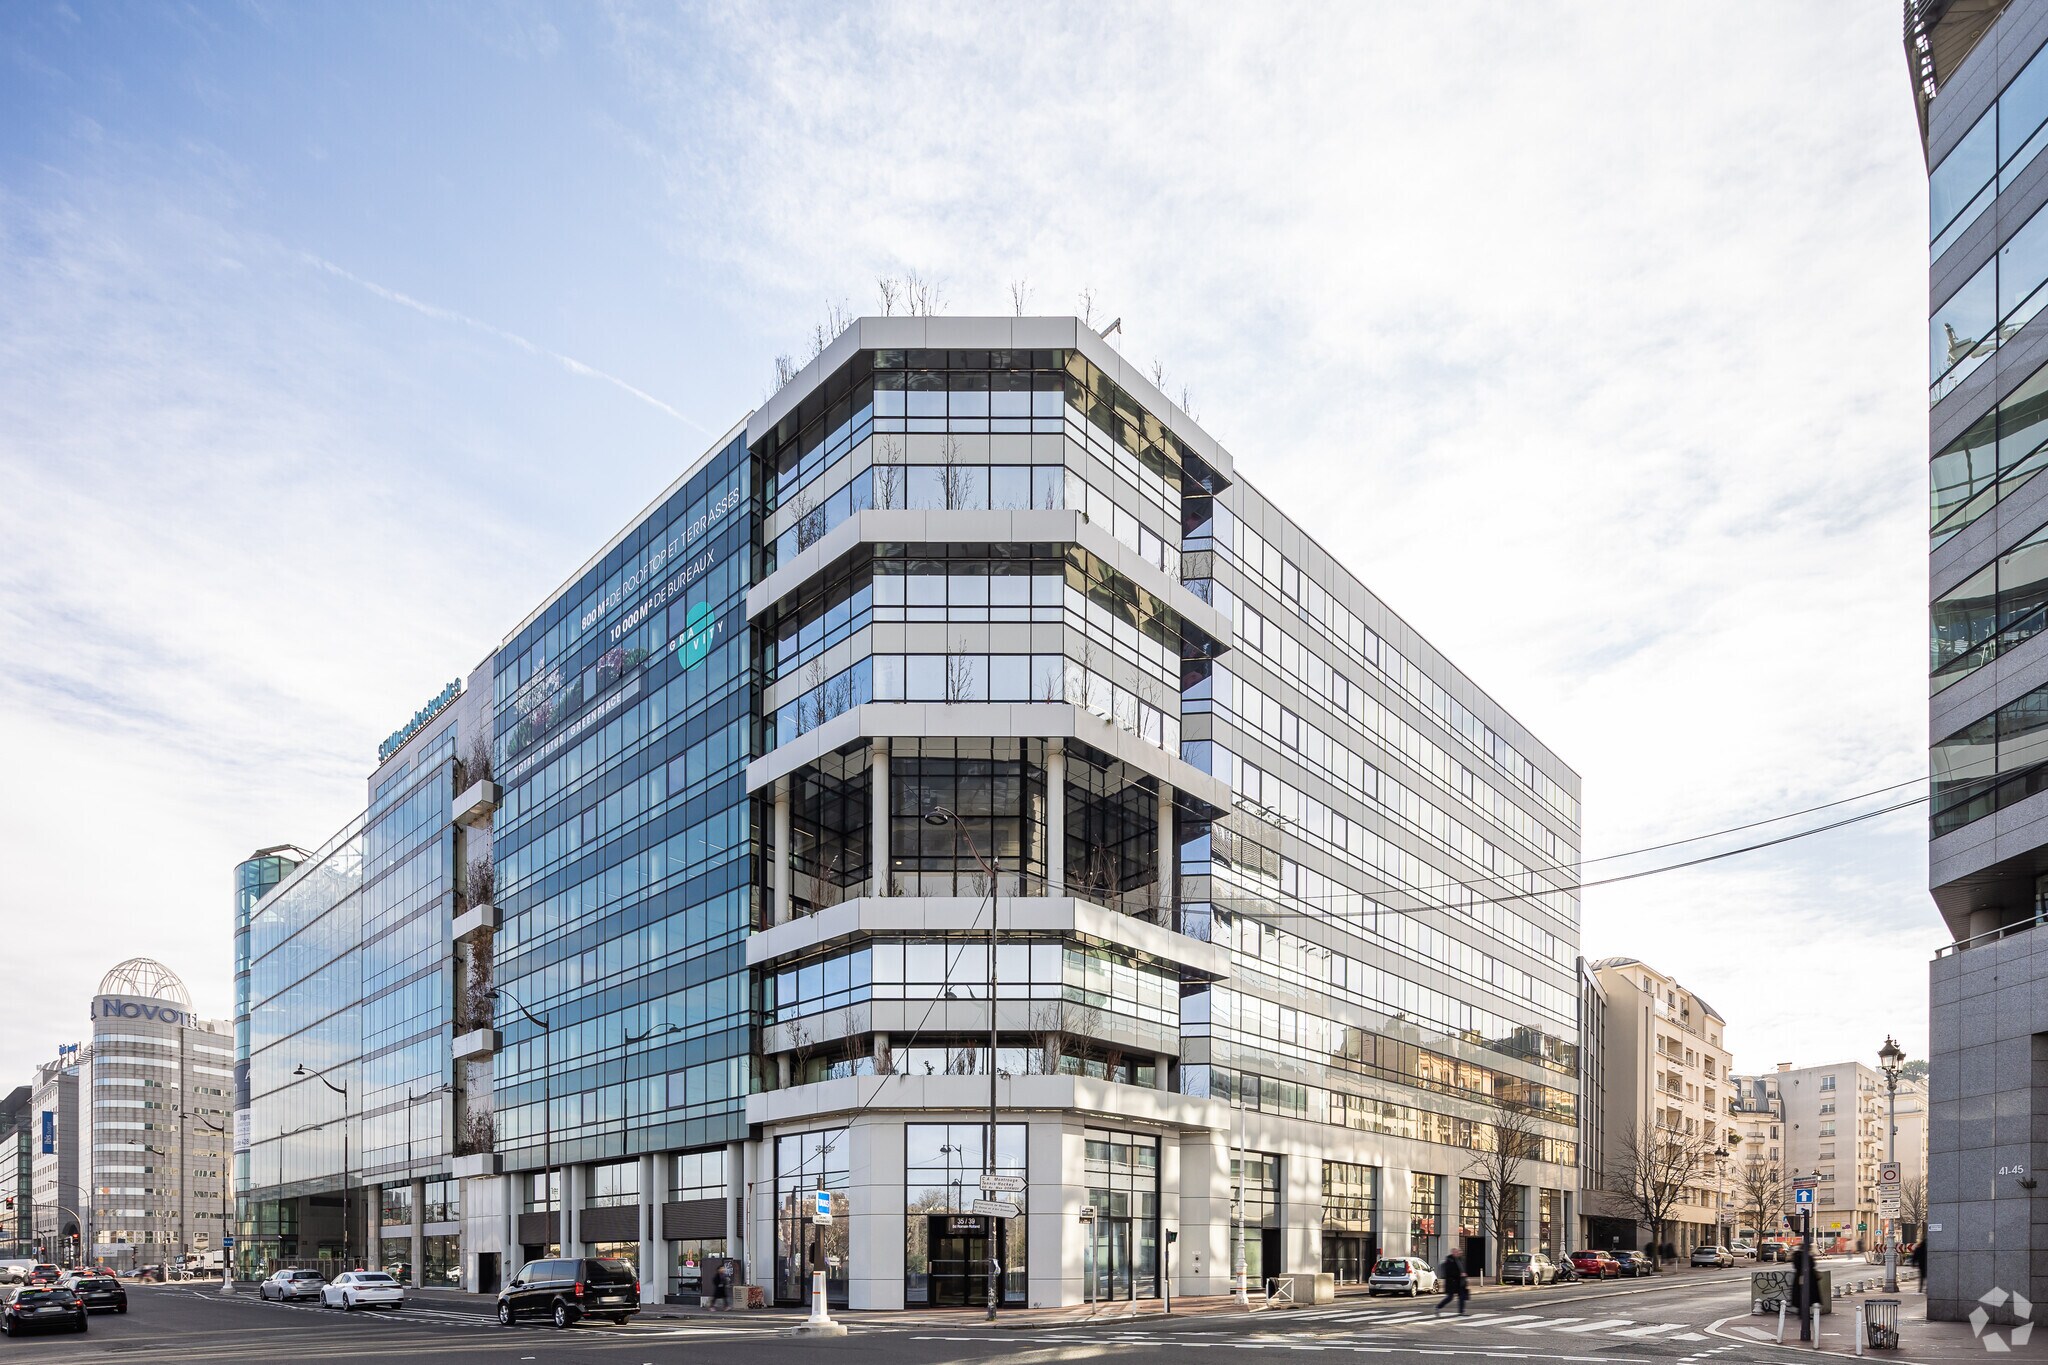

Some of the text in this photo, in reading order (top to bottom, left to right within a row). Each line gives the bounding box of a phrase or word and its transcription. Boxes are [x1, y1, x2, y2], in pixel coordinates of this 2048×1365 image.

[610, 587, 622, 607] DE
[668, 538, 679, 559] ET
[681, 487, 739, 547] TERRASSES
[654, 587, 667, 608] DE
[667, 548, 715, 598] BUREAUX
[514, 753, 535, 775] VOTRE
[540, 734, 564, 757] FUTUR
[102, 998, 198, 1028] NOVOTE
[1999, 1165, 2024, 1175] 41-45
